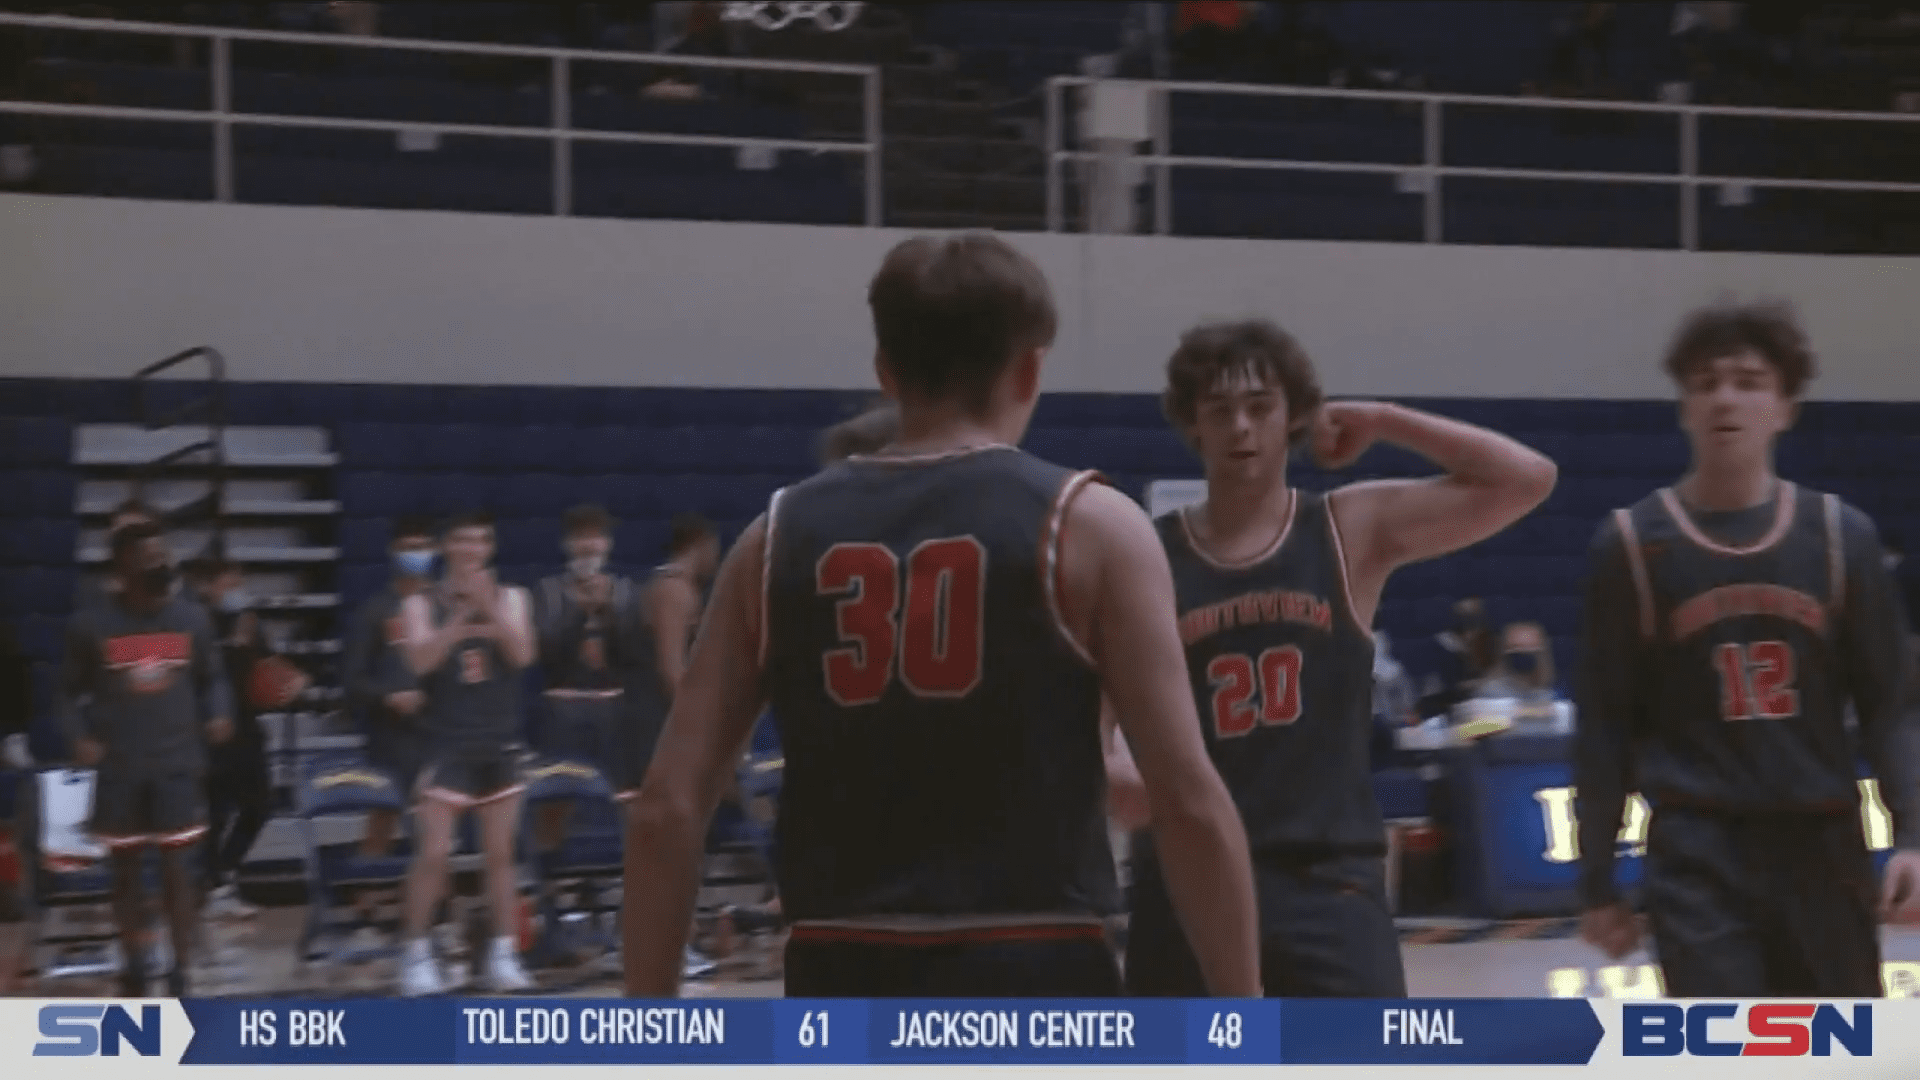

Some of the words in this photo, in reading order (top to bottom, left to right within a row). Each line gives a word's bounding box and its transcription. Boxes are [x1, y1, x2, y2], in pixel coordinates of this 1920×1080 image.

[816, 534, 986, 706] 30
[1208, 645, 1302, 739] 20
[1712, 640, 1800, 721] 12
